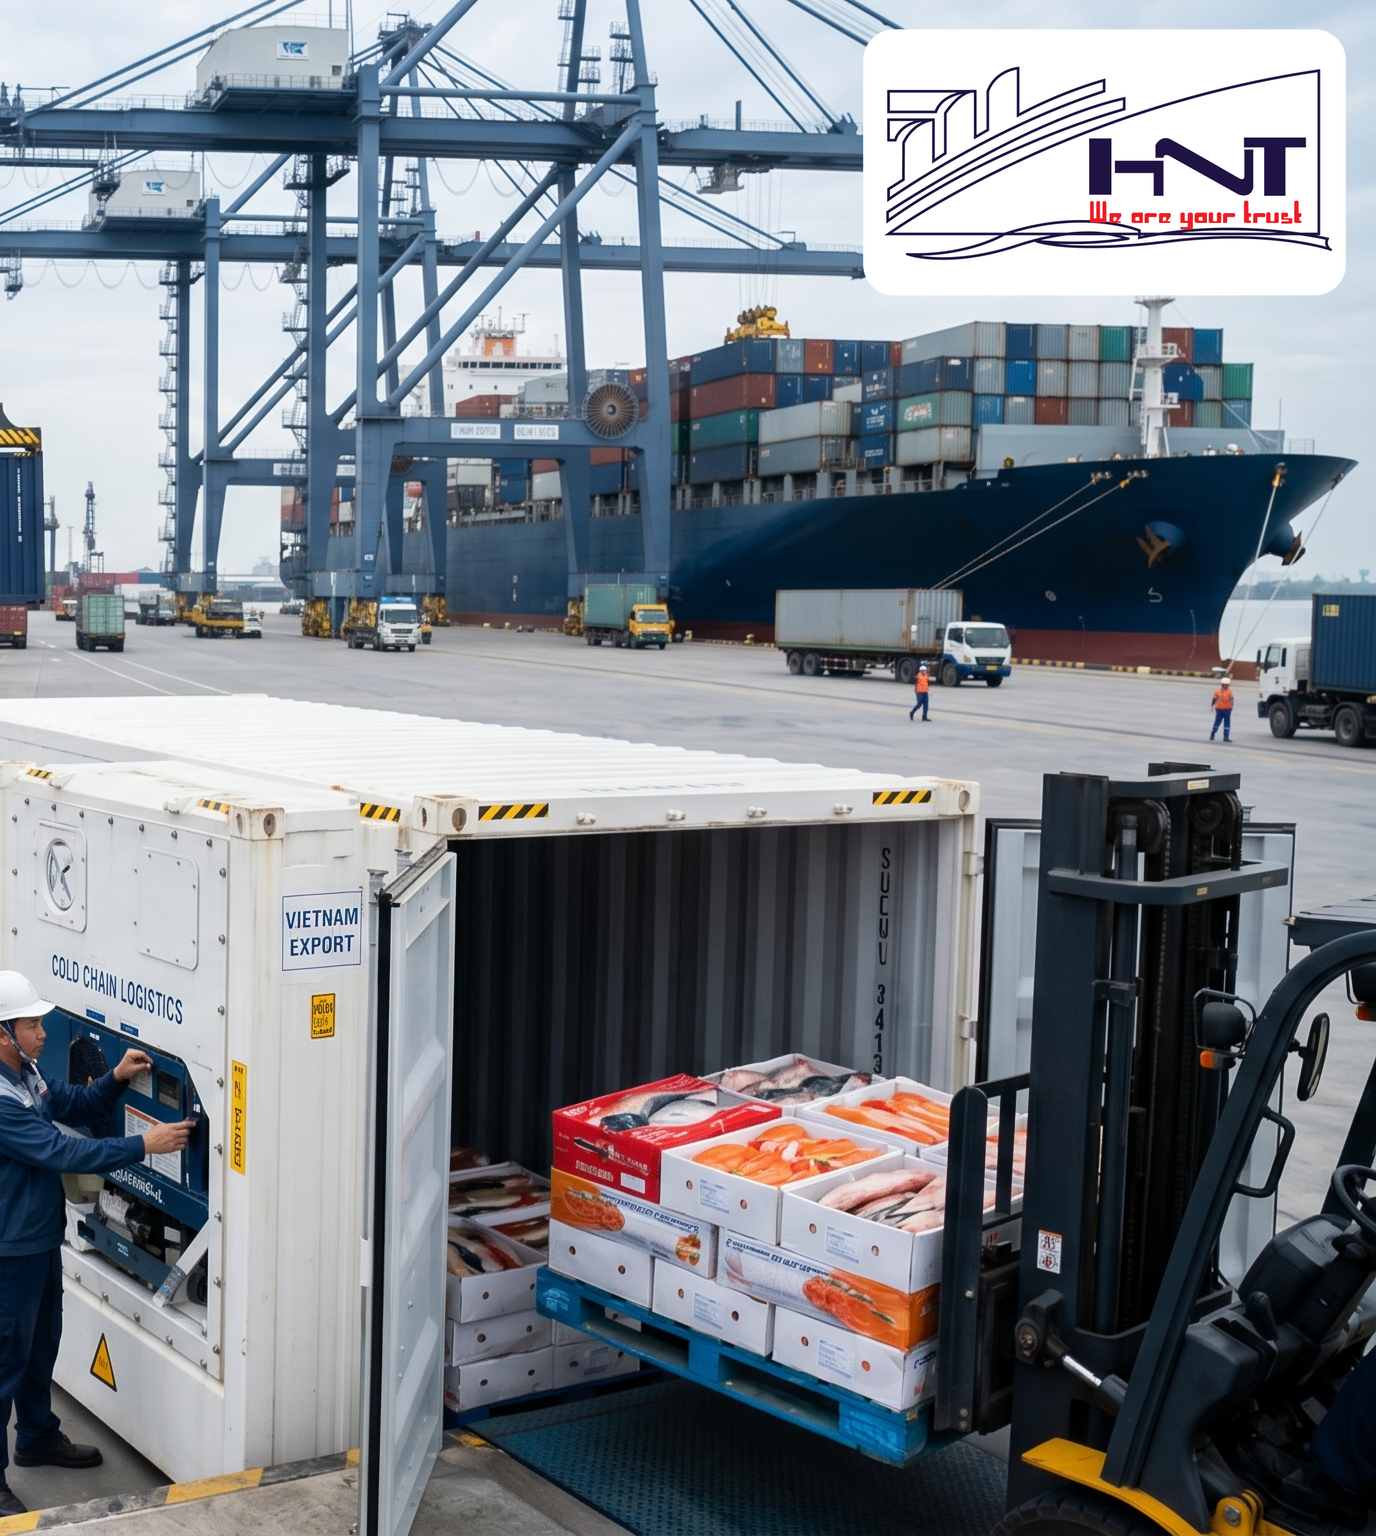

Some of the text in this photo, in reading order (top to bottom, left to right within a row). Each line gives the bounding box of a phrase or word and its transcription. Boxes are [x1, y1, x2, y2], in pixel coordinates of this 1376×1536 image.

[286, 907, 358, 929] VIETNAM
[290, 935, 354, 956] EXPORT
[52, 954, 183, 1025] COLD CHAIN LOGISTICS
